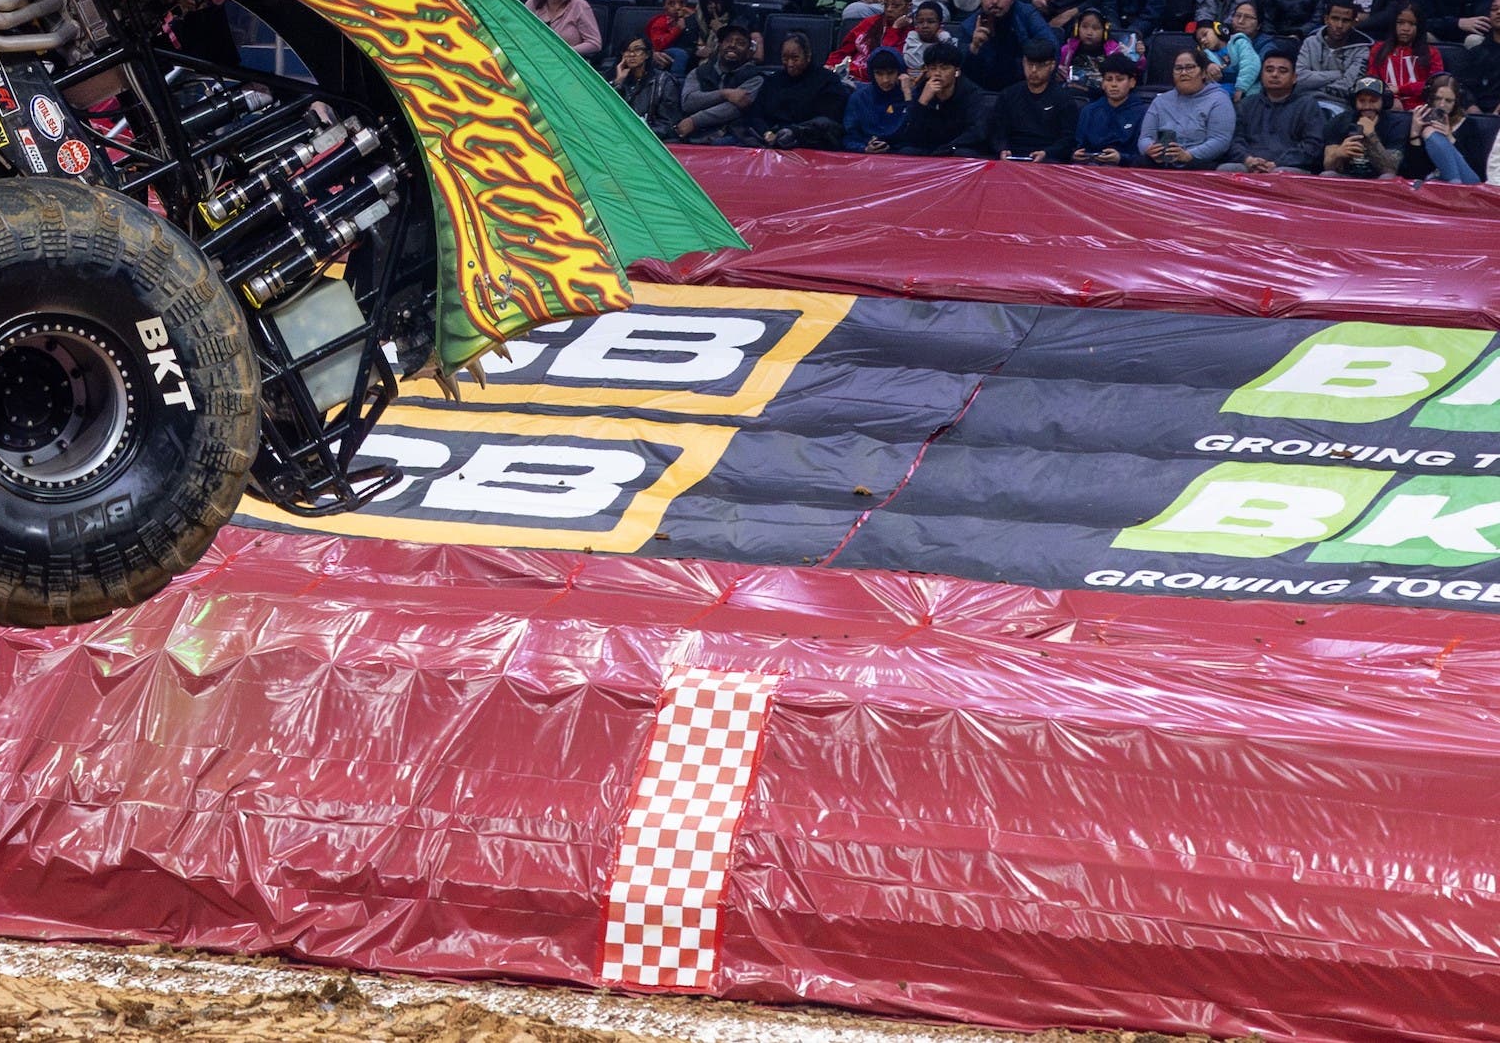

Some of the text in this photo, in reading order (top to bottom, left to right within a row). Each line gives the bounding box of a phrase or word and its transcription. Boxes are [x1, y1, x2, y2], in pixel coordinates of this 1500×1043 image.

[37, 100, 58, 134] TOTAL SEAL
[27, 146, 44, 172] KING
[70, 144, 84, 164] NGK
[134, 316, 195, 413] BKT
[1193, 434, 1456, 467] GROWING
[1084, 569, 1351, 596] GROWING
